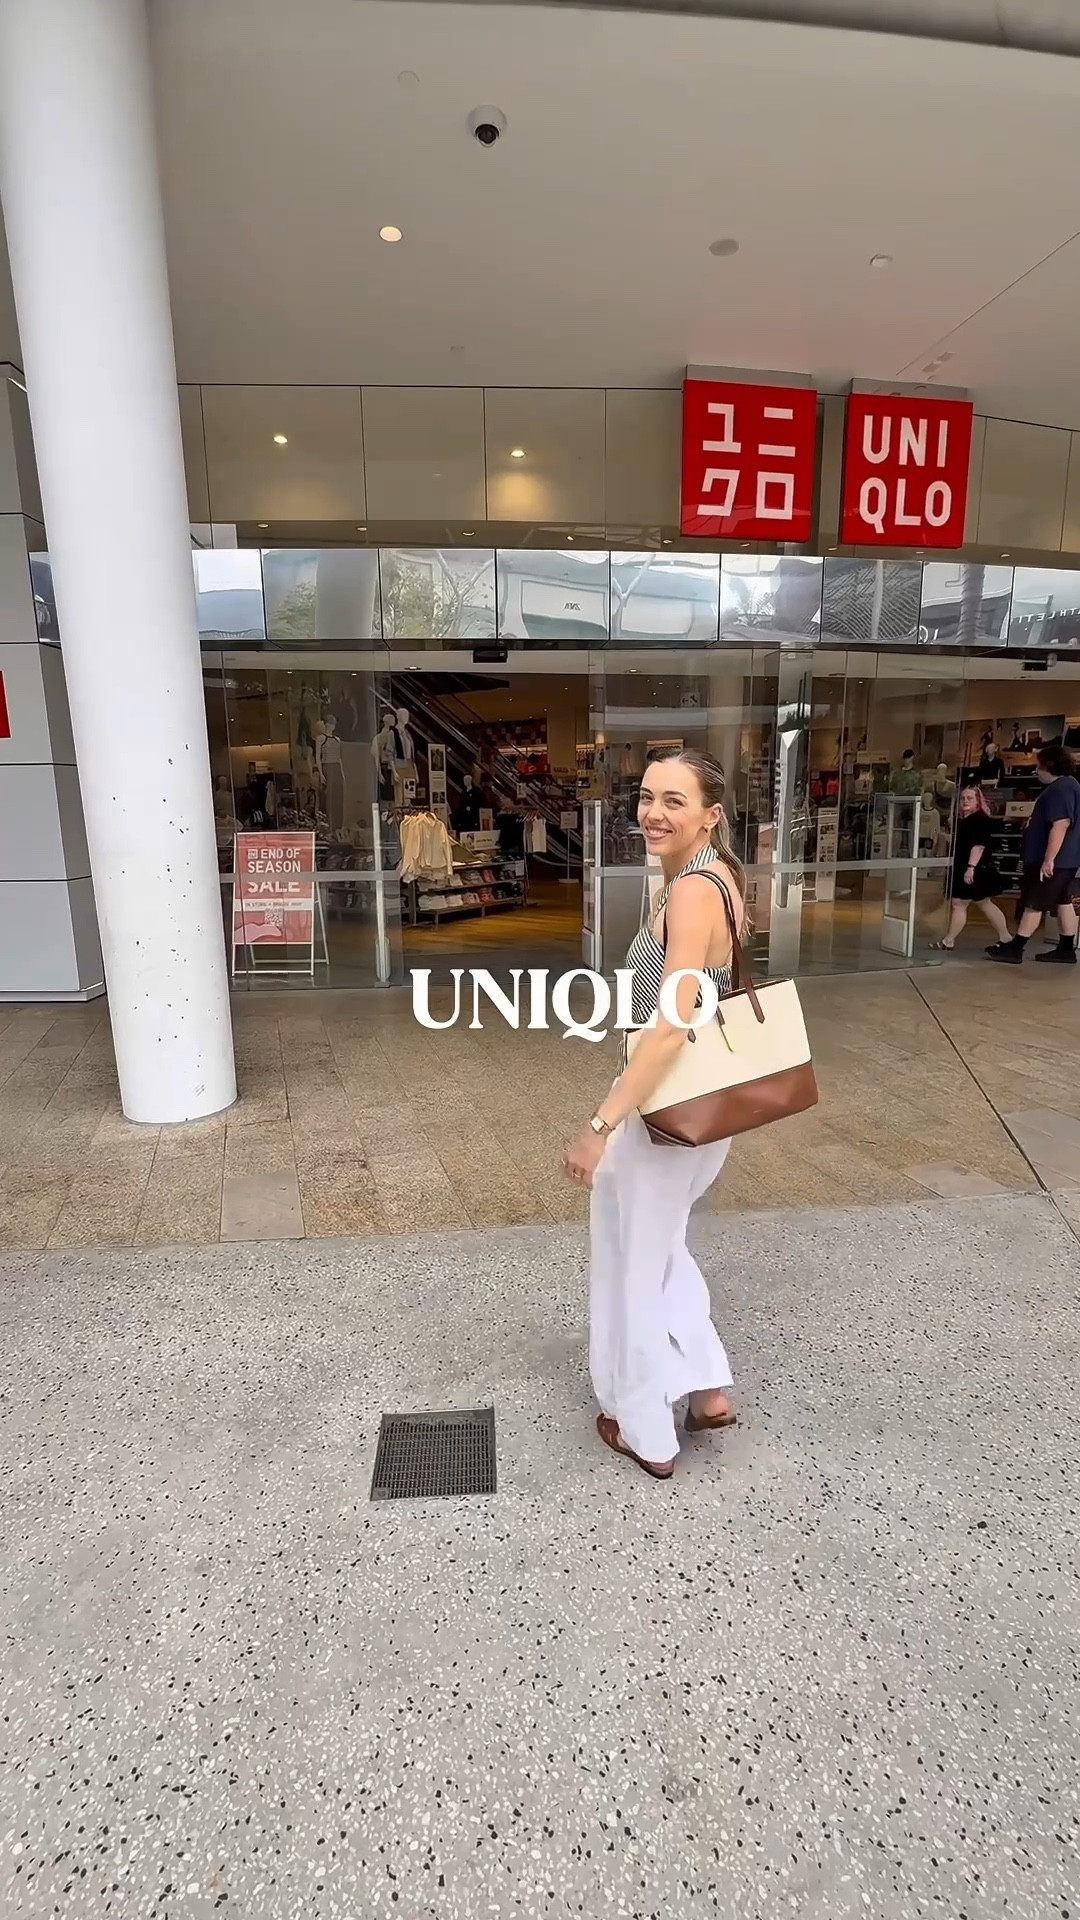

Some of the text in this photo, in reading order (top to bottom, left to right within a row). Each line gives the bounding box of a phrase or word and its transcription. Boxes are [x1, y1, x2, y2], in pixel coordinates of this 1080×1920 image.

[862, 414, 949, 467] UNI
[859, 477, 952, 534] QLO
[260, 848, 284, 859] END
[286, 848, 301, 858] OF
[247, 860, 301, 873] SEASON
[247, 881, 301, 893] SALE
